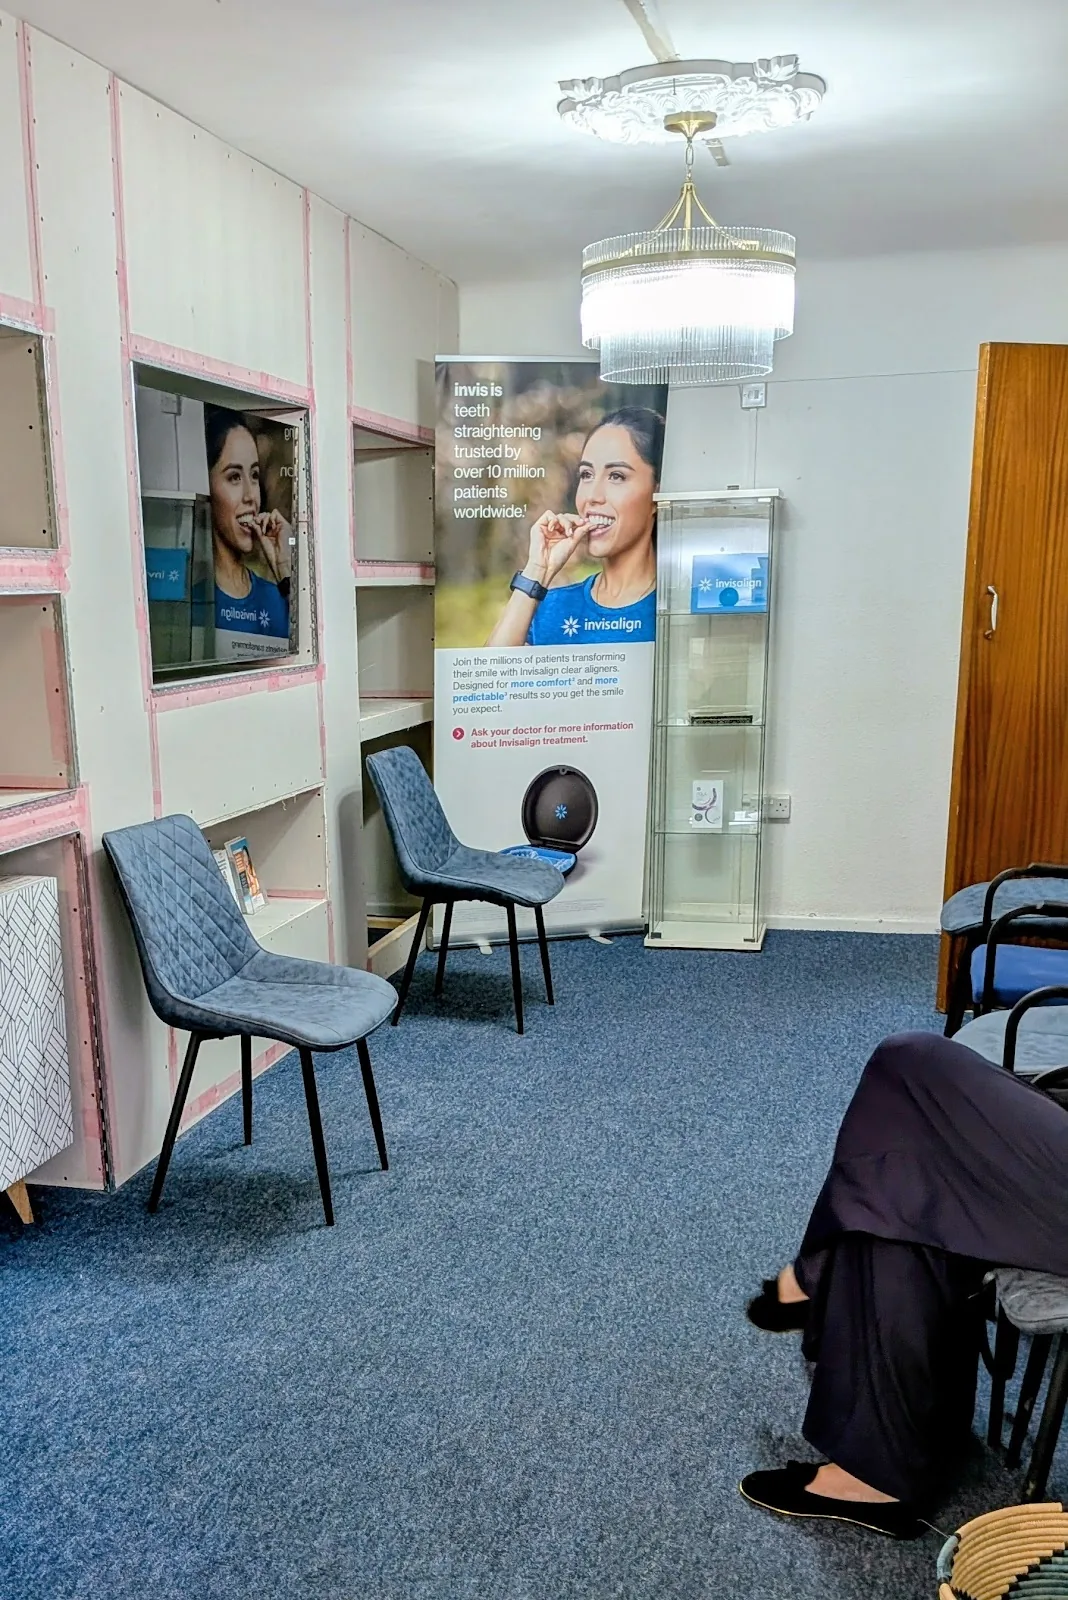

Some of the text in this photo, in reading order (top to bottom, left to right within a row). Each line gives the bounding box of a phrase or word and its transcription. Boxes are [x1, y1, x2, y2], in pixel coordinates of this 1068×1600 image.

[454, 382, 503, 397] invis is
[454, 403, 490, 417] teeth
[454, 424, 542, 440] straightening
[454, 444, 521, 460] trusted by
[454, 465, 545, 479] over 10 million
[454, 485, 508, 501] patients
[716, 578, 761, 589] invisalign
[584, 618, 642, 633] invisalign
[453, 653, 626, 667] Join the millions of patients transforming
[453, 665, 620, 678] their smile with Invisalign clear aligners.
[453, 682, 494, 691] Designed
[496, 680, 509, 688] for
[511, 680, 534, 688] more
[577, 677, 593, 685] and
[595, 676, 618, 684] more
[509, 691, 538, 699] results
[552, 690, 568, 700] you
[570, 689, 584, 698] get
[586, 688, 600, 696] the
[602, 688, 624, 696] smile
[452, 704, 503, 715] you expect.
[471, 728, 488, 736] Ask
[490, 727, 510, 737] your
[512, 726, 543, 735] doctor
[544, 725, 557, 734] for
[583, 722, 634, 731] information
[471, 736, 588, 748] about Invisalign treatment.
